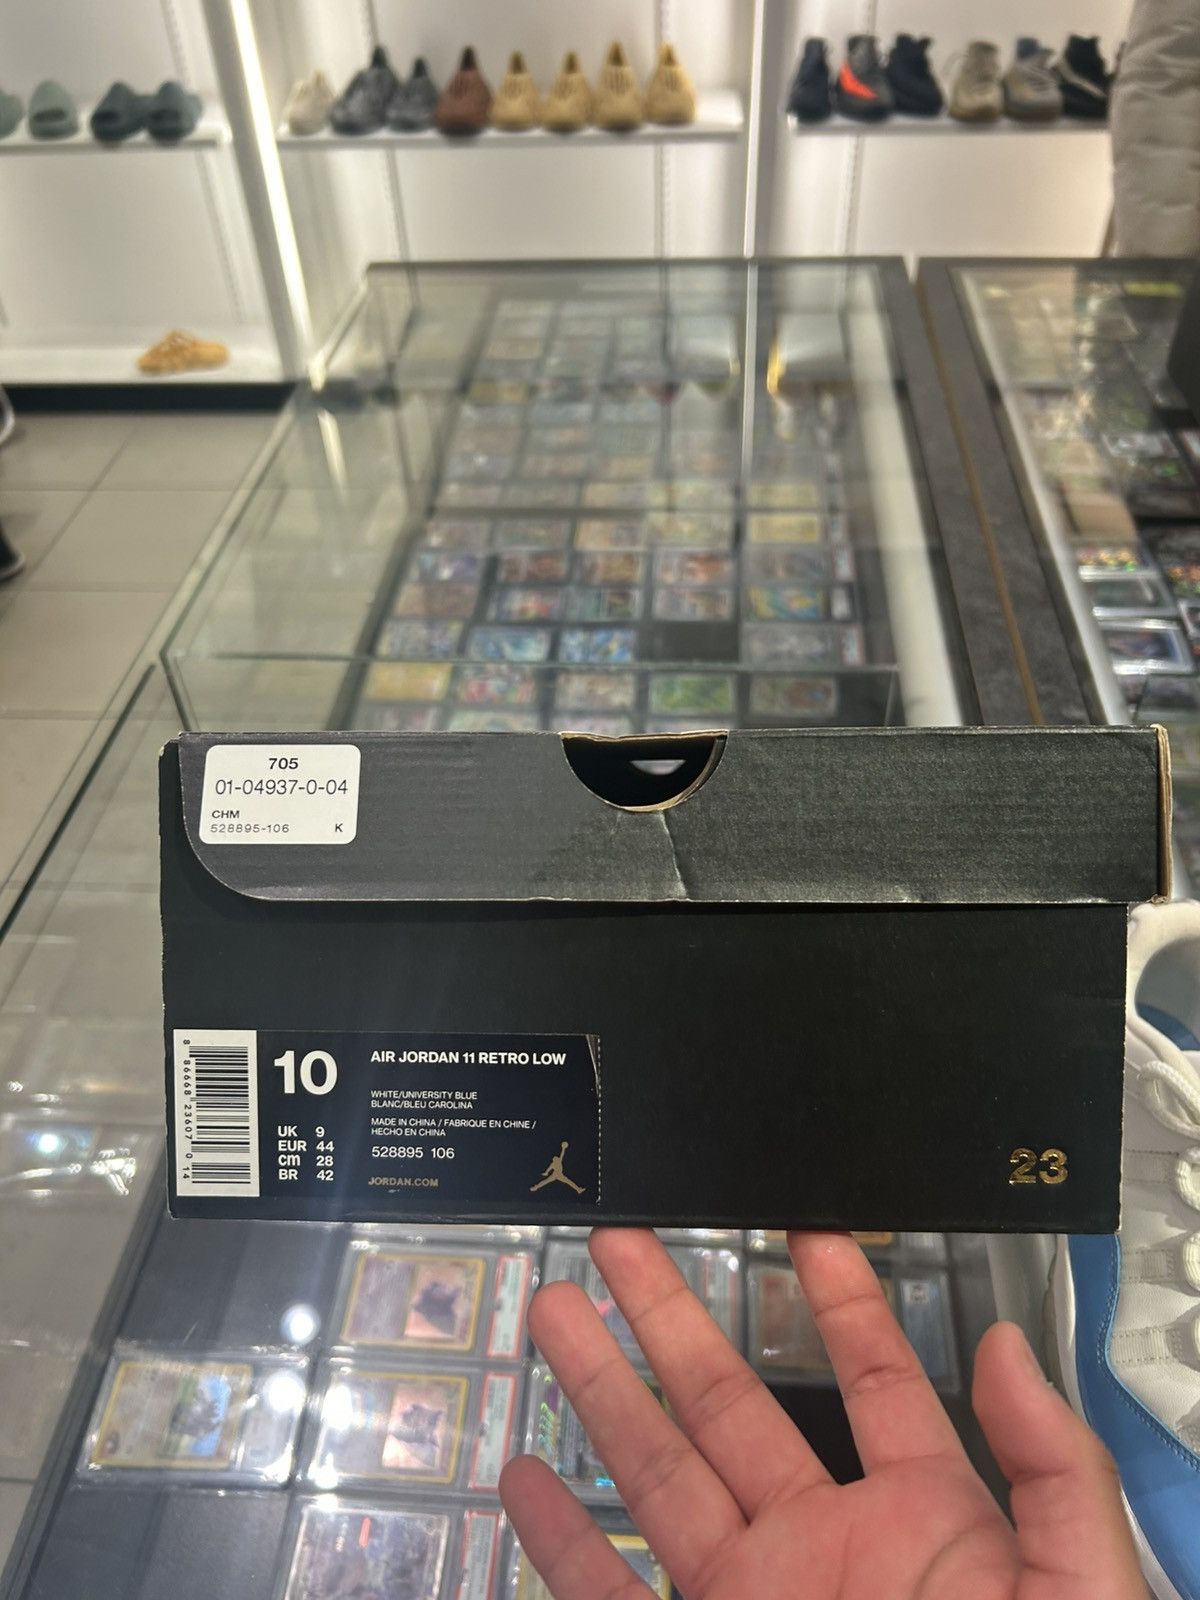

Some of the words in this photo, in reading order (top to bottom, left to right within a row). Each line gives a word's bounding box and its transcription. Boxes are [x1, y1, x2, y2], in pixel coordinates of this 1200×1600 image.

[269, 757, 299, 770] 705
[215, 779, 348, 794] 01-04937-0-04
[211, 810, 240, 819] CHM
[210, 824, 290, 833] 528895-106
[334, 823, 344, 832] K
[370, 1051, 396, 1063] AIR
[398, 1051, 459, 1064] JORDAN
[462, 1052, 475, 1064] 11
[478, 1052, 530, 1065] RETRO
[532, 1053, 567, 1066] LOW
[183, 1060, 192, 1096] 86668
[273, 1050, 338, 1096] 10
[370, 1090, 453, 1100] WHITE/UNIVERSITY
[455, 1091, 478, 1100] BLUE
[370, 1100, 427, 1109] BLANC/BLEU
[428, 1100, 473, 1109] CAROLINA
[184, 1104, 193, 1140] 23607
[371, 1118, 396, 1127] MADE
[398, 1118, 407, 1126] IN
[408, 1118, 436, 1127] CHINA
[444, 1119, 487, 1128] FABRIQUE
[489, 1120, 502, 1128] EN
[503, 1120, 530, 1129] CHINE
[277, 1125, 298, 1137] UK
[315, 1126, 325, 1138] 9
[371, 1127, 403, 1136] HECHO
[405, 1128, 417, 1136] EN
[418, 1128, 446, 1137] CHINA
[278, 1140, 307, 1152] EUR
[315, 1141, 335, 1152] 44
[371, 1146, 424, 1159] 528895
[430, 1147, 455, 1159] 106
[278, 1154, 301, 1166] cm
[316, 1155, 334, 1167] 28
[1008, 1147, 1069, 1184] 23
[278, 1169, 298, 1181] BR
[316, 1169, 334, 1181] 42
[367, 1176, 439, 1188] JORDAN.COM
